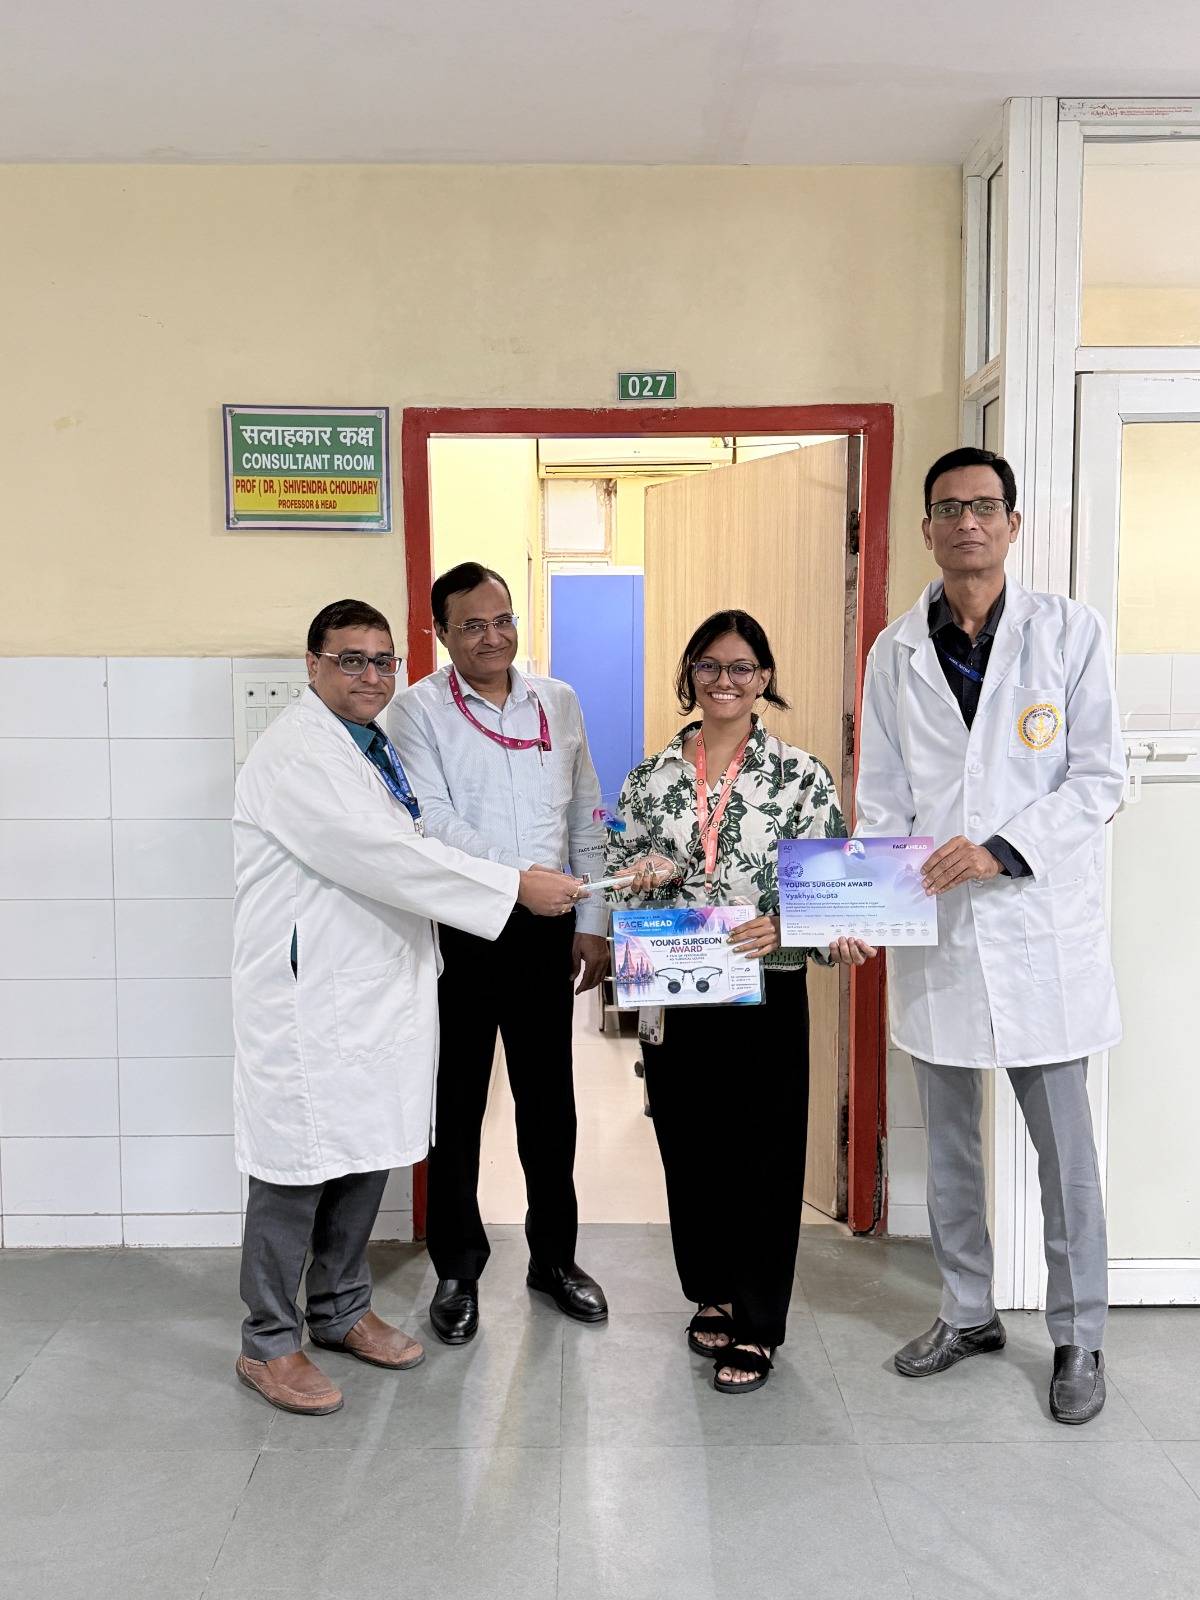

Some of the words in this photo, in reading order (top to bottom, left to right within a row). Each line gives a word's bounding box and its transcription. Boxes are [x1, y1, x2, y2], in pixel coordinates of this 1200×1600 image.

[628, 376, 667, 396] 027
[239, 425, 332, 448] सलाहकार
[337, 427, 374, 447] कक्ष
[242, 453, 330, 470] CONSULTANT
[334, 454, 375, 471] ROOM
[235, 479, 257, 493] PROF
[283, 480, 328, 494] SHIVENDRA
[329, 480, 378, 495] CHOUDHARY
[278, 499, 314, 509] PROFESSOR
[315, 500, 320, 509] &
[320, 500, 337, 509] HEAD
[650, 938, 681, 947] YOUNG
[682, 937, 722, 946] SURGEON
[669, 945, 703, 953] AWARD
